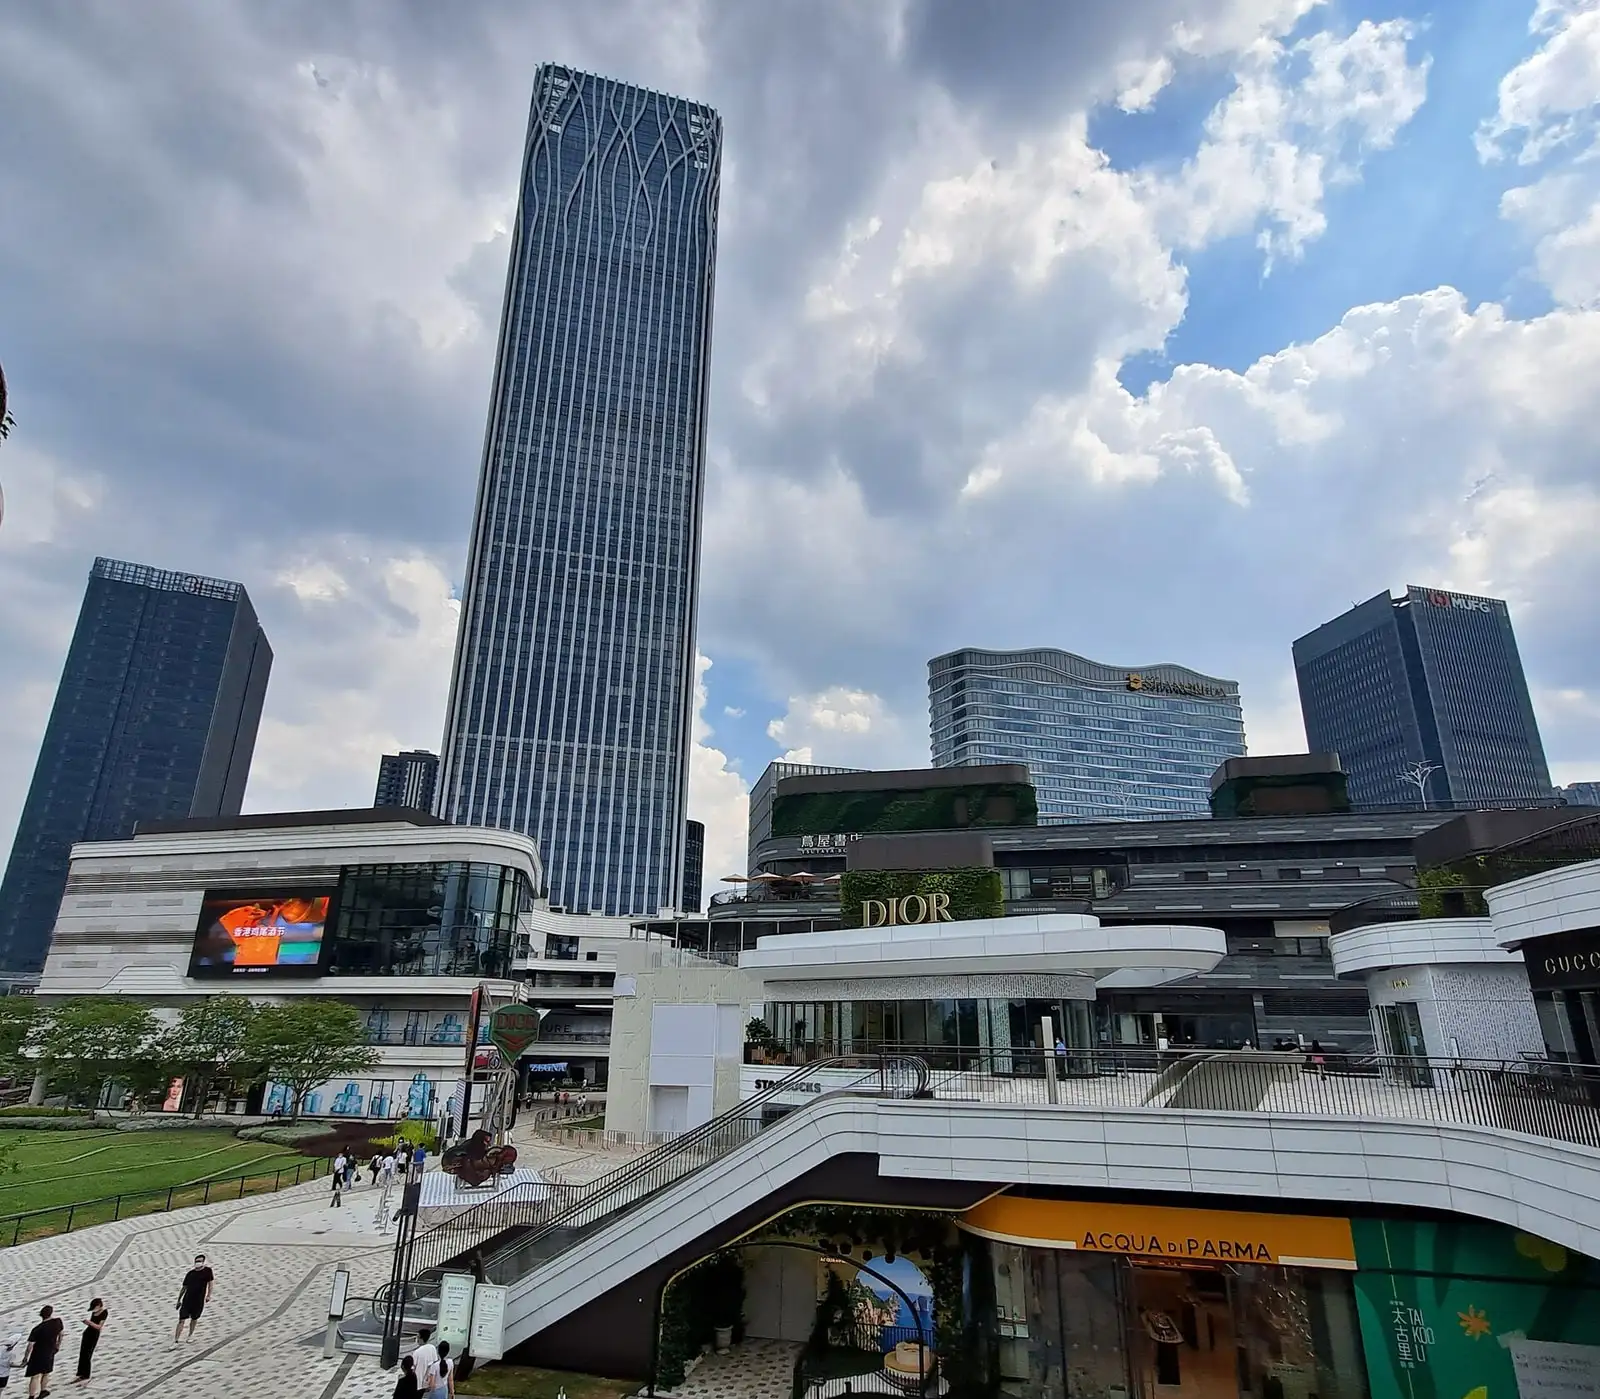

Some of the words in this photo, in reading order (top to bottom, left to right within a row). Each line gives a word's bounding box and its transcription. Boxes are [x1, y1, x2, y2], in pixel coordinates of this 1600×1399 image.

[1451, 597, 1490, 613] MUFG
[860, 892, 955, 928] DIOR
[1083, 1231, 1163, 1253] ACQUA
[1167, 1242, 1183, 1254] DI
[1187, 1238, 1272, 1261] PARMA
[1407, 1307, 1425, 1326] TAI
[1392, 1307, 1414, 1361] 太古里
[1412, 1326, 1436, 1345] KOO
